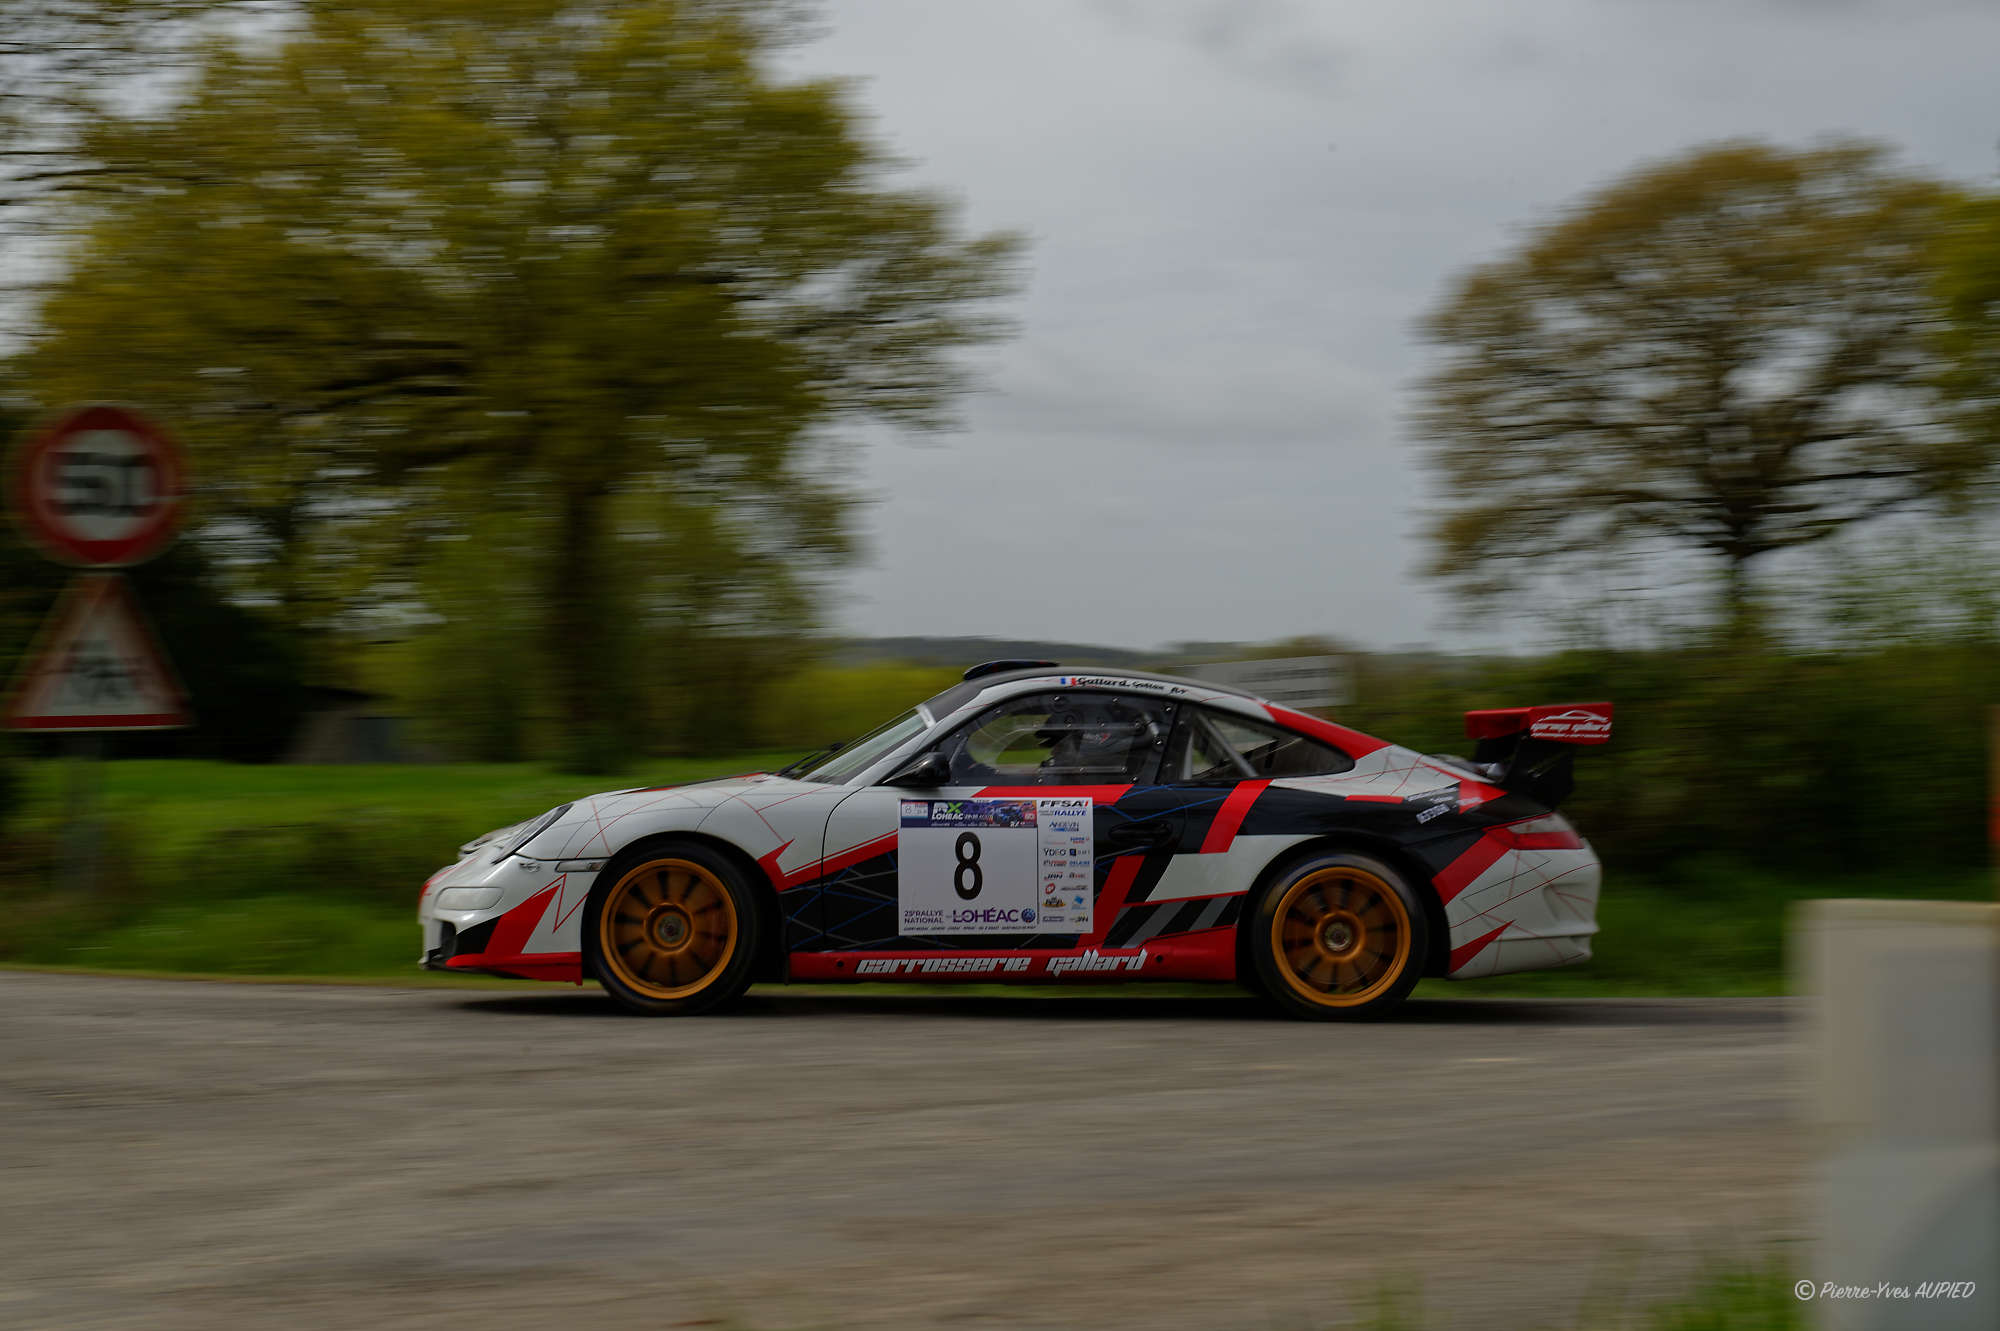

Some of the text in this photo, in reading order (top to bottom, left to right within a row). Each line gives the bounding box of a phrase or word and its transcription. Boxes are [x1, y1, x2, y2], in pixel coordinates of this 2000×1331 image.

[954, 831, 983, 900] 8
[952, 907, 1019, 923] LOHÉAC
[856, 949, 1147, 977] carrosserie gallard
